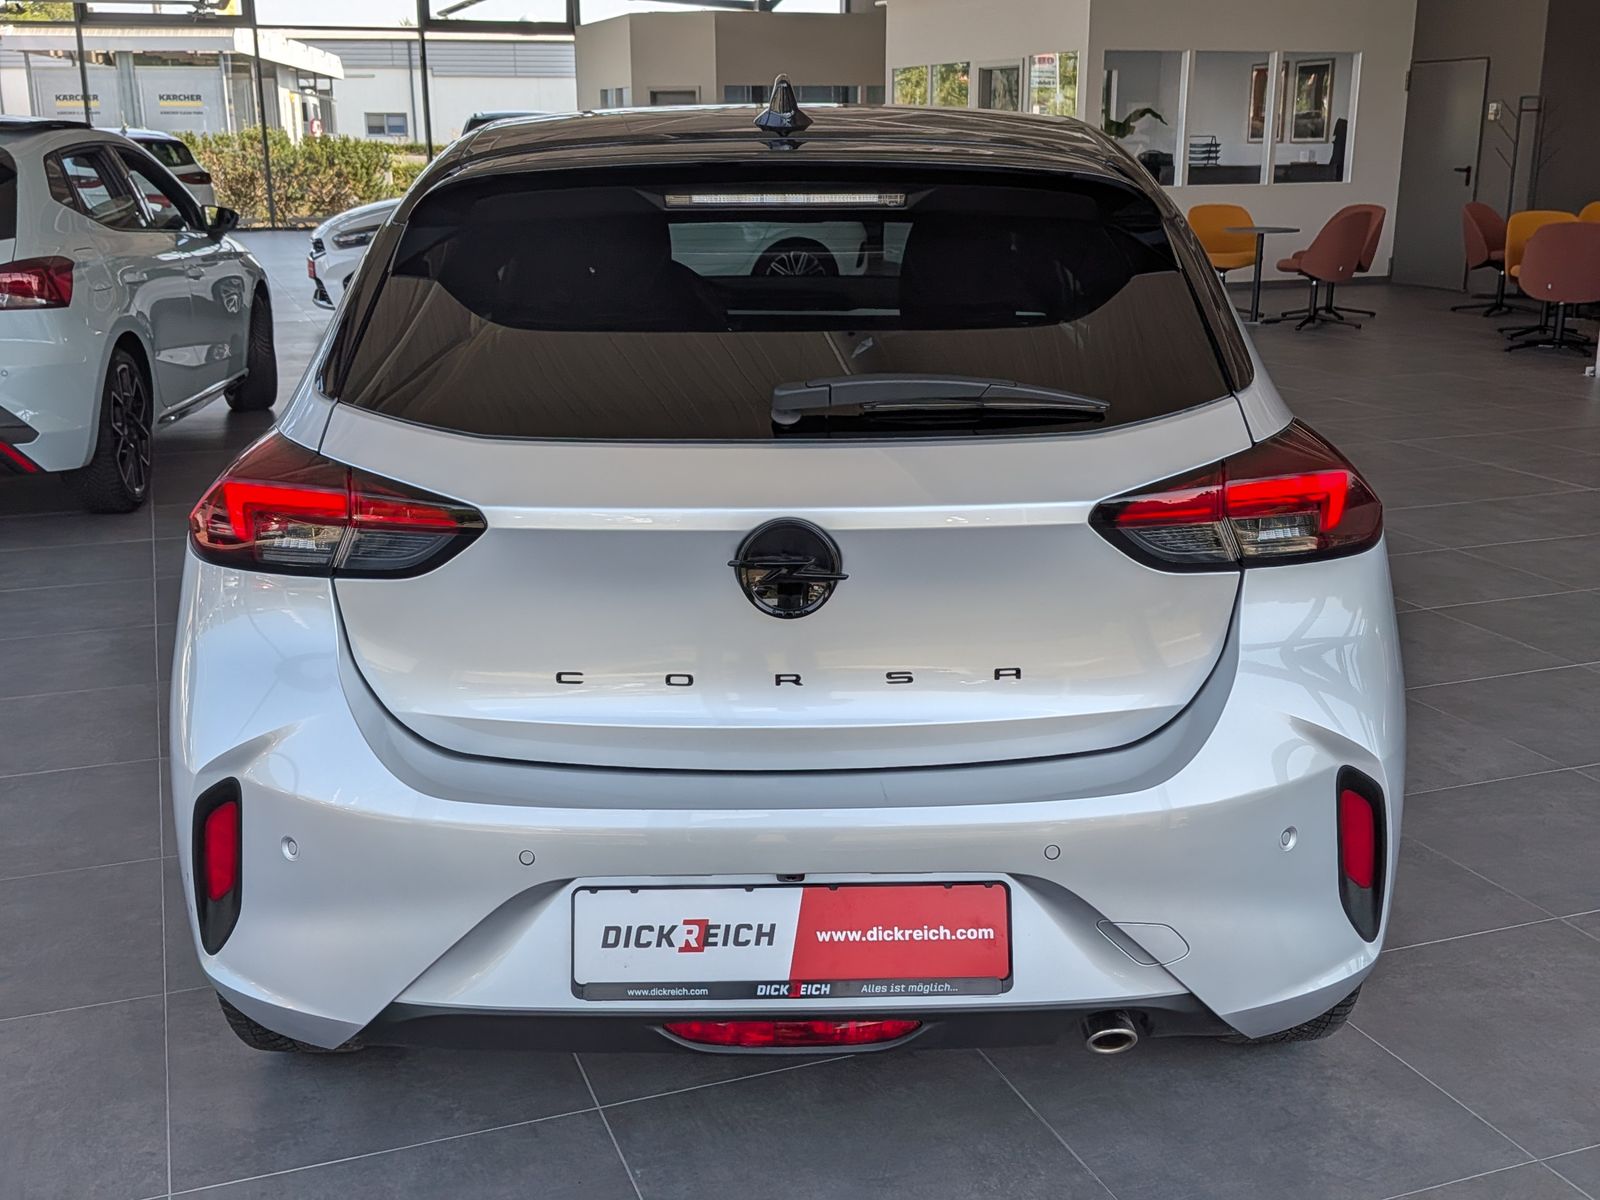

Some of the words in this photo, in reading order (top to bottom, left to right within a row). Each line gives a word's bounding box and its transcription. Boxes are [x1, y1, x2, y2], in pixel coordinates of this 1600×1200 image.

[556, 667, 1021, 687] CORSA
[601, 922, 776, 949] DICKREICH
[816, 926, 995, 942] www.dickreich.com
[627, 986, 709, 996] www.dickreich.com
[756, 983, 831, 997] DICKEICH
[860, 984, 888, 993] Alles
[889, 983, 906, 993] ist
[907, 982, 959, 994] möglich...
